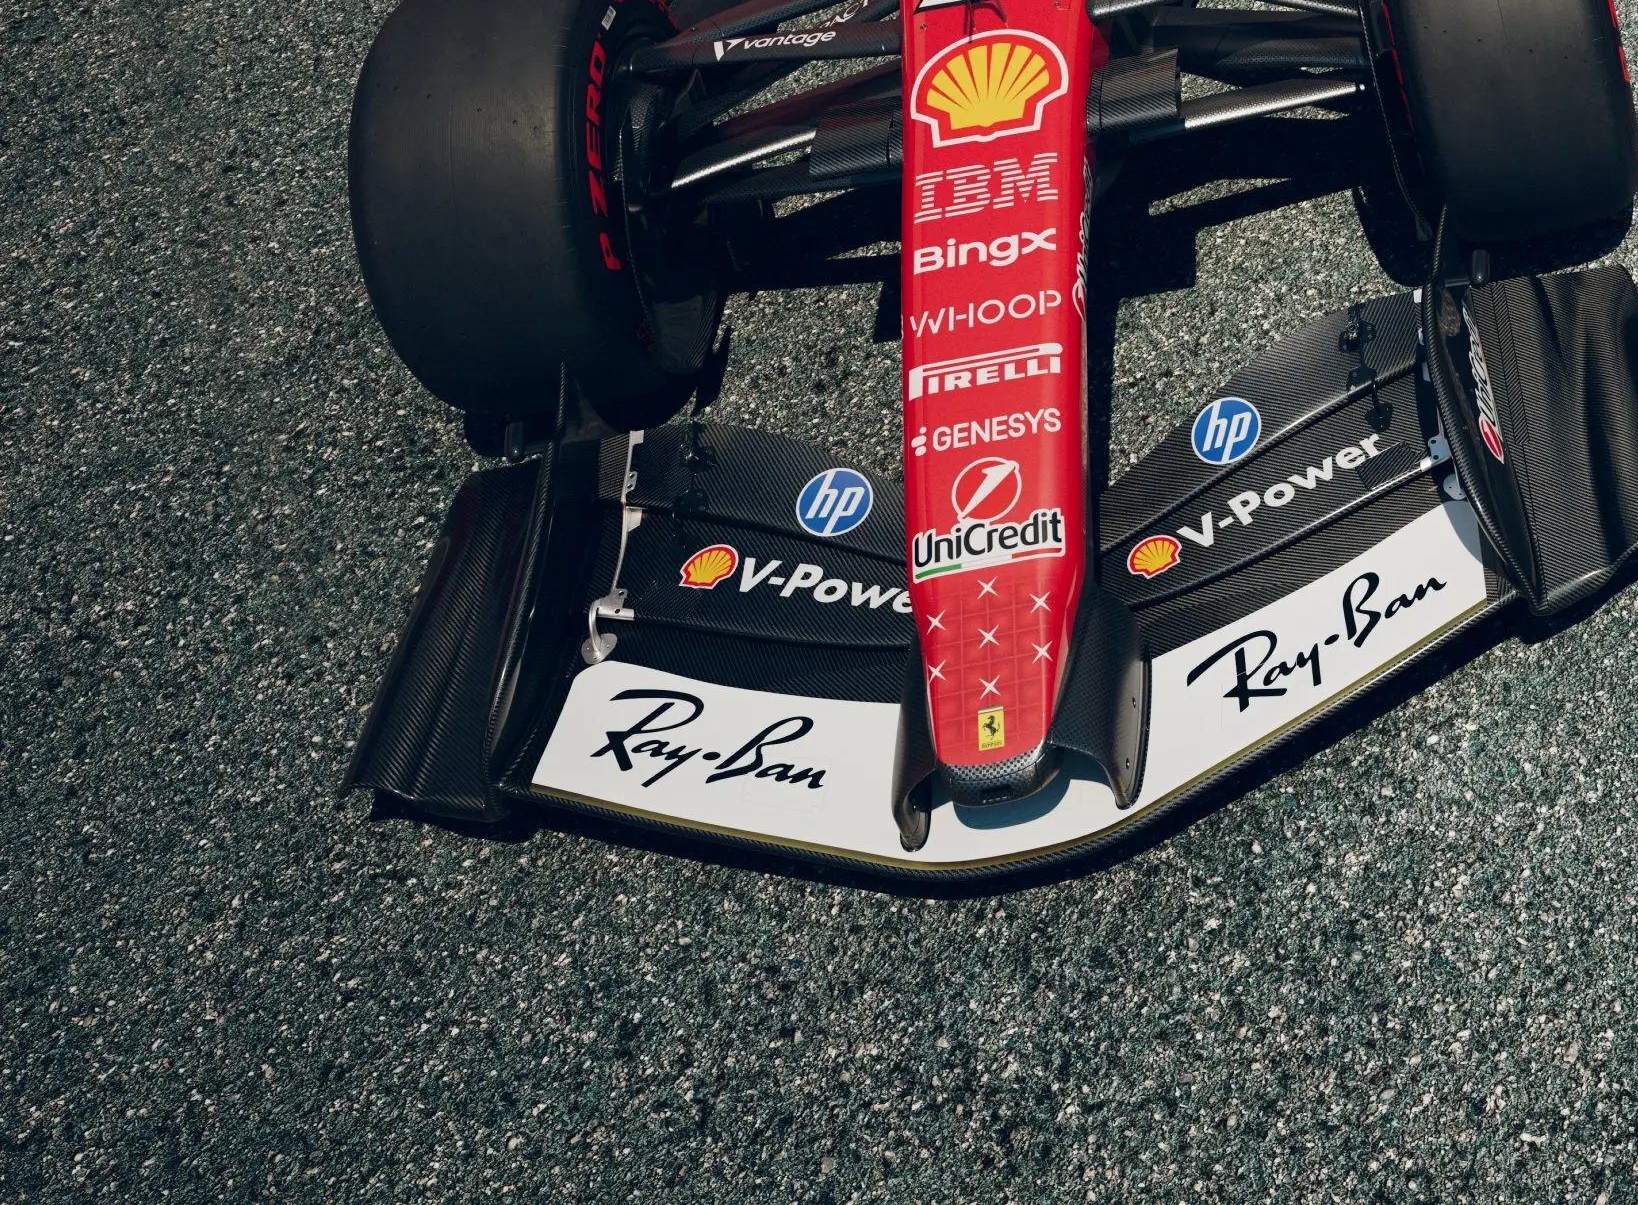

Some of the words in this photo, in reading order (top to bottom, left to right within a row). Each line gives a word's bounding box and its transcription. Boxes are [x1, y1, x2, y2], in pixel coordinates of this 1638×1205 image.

[744, 30, 837, 50] vantage
[585, 43, 610, 218] ZERO
[913, 152, 1059, 224] IBM
[600, 233, 622, 270] P
[909, 290, 1062, 338] WHOOP
[908, 342, 1063, 401] PIRELLI
[933, 407, 1062, 452] GENESYS
[1203, 398, 1251, 464] hp
[808, 468, 855, 536] hp
[1176, 433, 1384, 548] V-Power
[913, 511, 1063, 568] UniCredit
[739, 557, 913, 615] V-Powe
[1186, 571, 1448, 713] Ray-Ban
[590, 688, 827, 788] Ray-Ban
